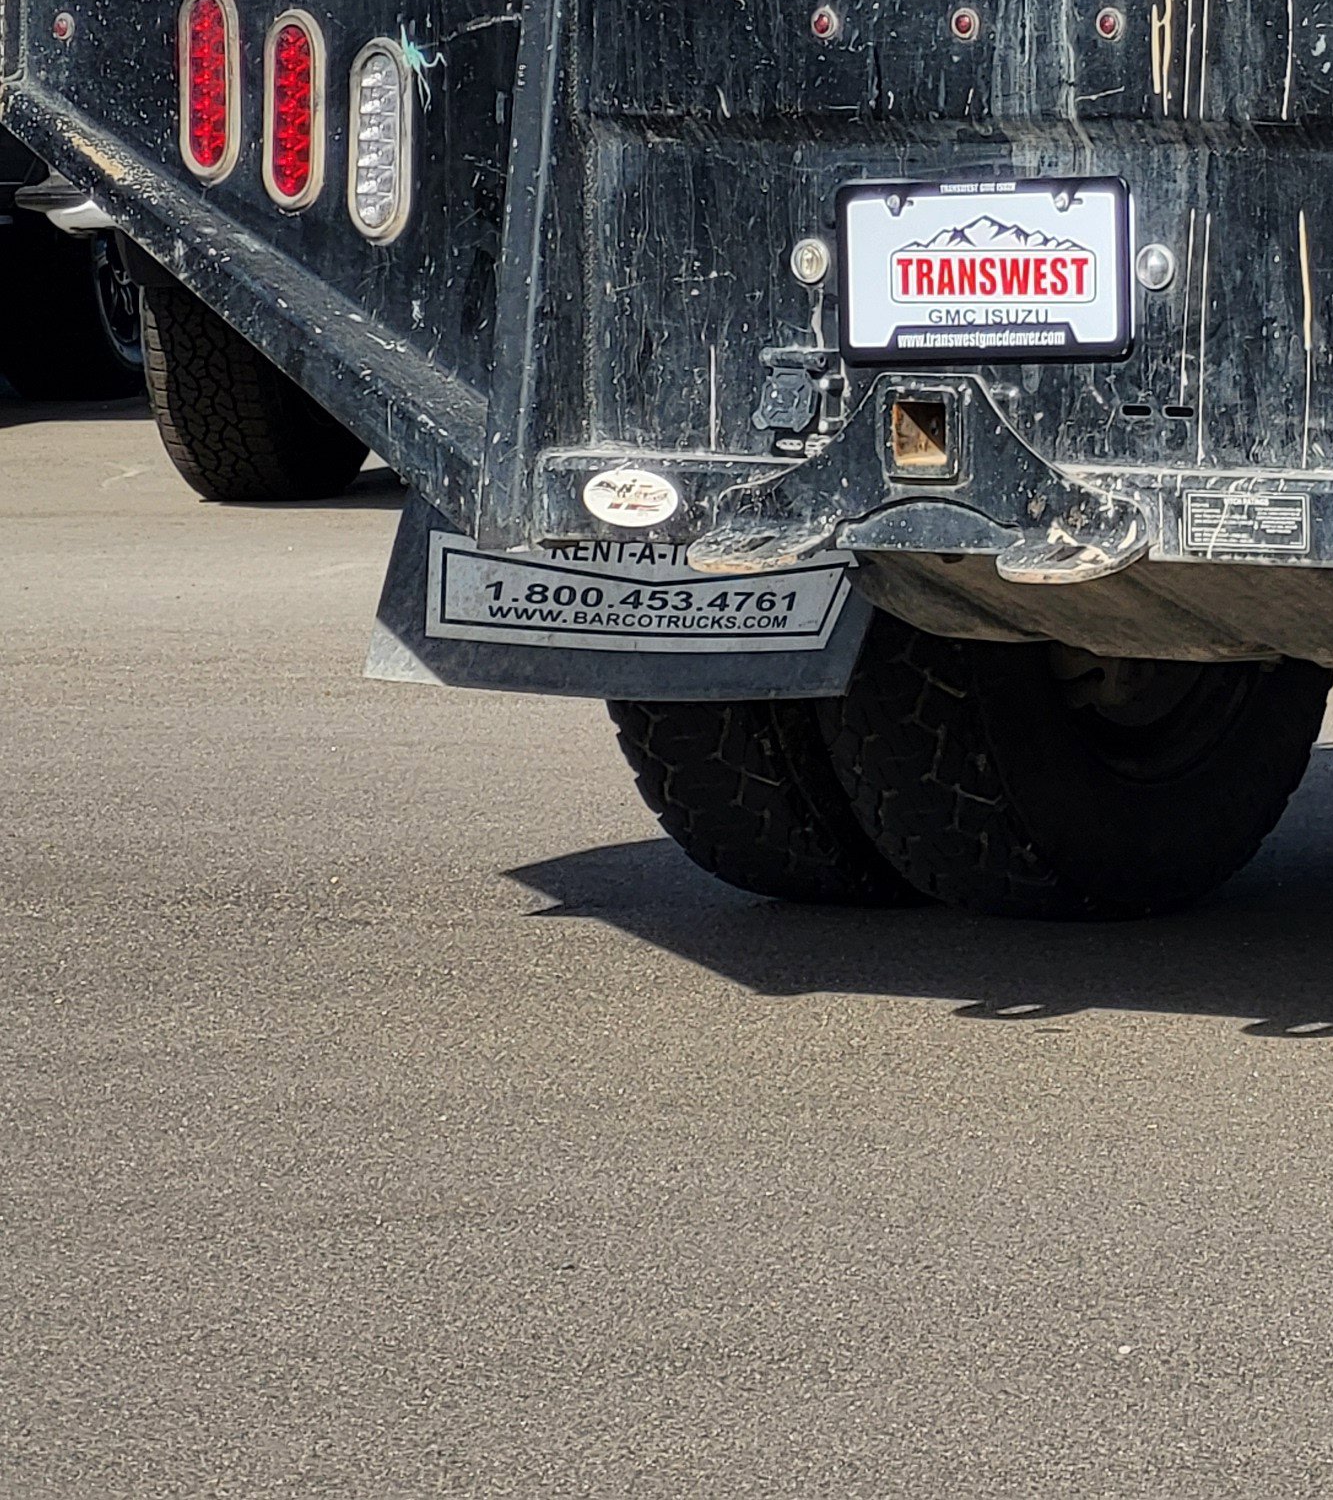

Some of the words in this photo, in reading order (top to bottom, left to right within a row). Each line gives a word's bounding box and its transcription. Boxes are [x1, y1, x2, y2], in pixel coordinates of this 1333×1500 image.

[897, 257, 1089, 295] TRANSWEST
[928, 308, 977, 324] GMC
[985, 308, 1049, 324] ISUZU
[898, 331, 1066, 348] www.transwestgmcdenver.com
[552, 542, 689, 566] ENT-A-T
[485, 581, 797, 612] 1.800.453.4761
